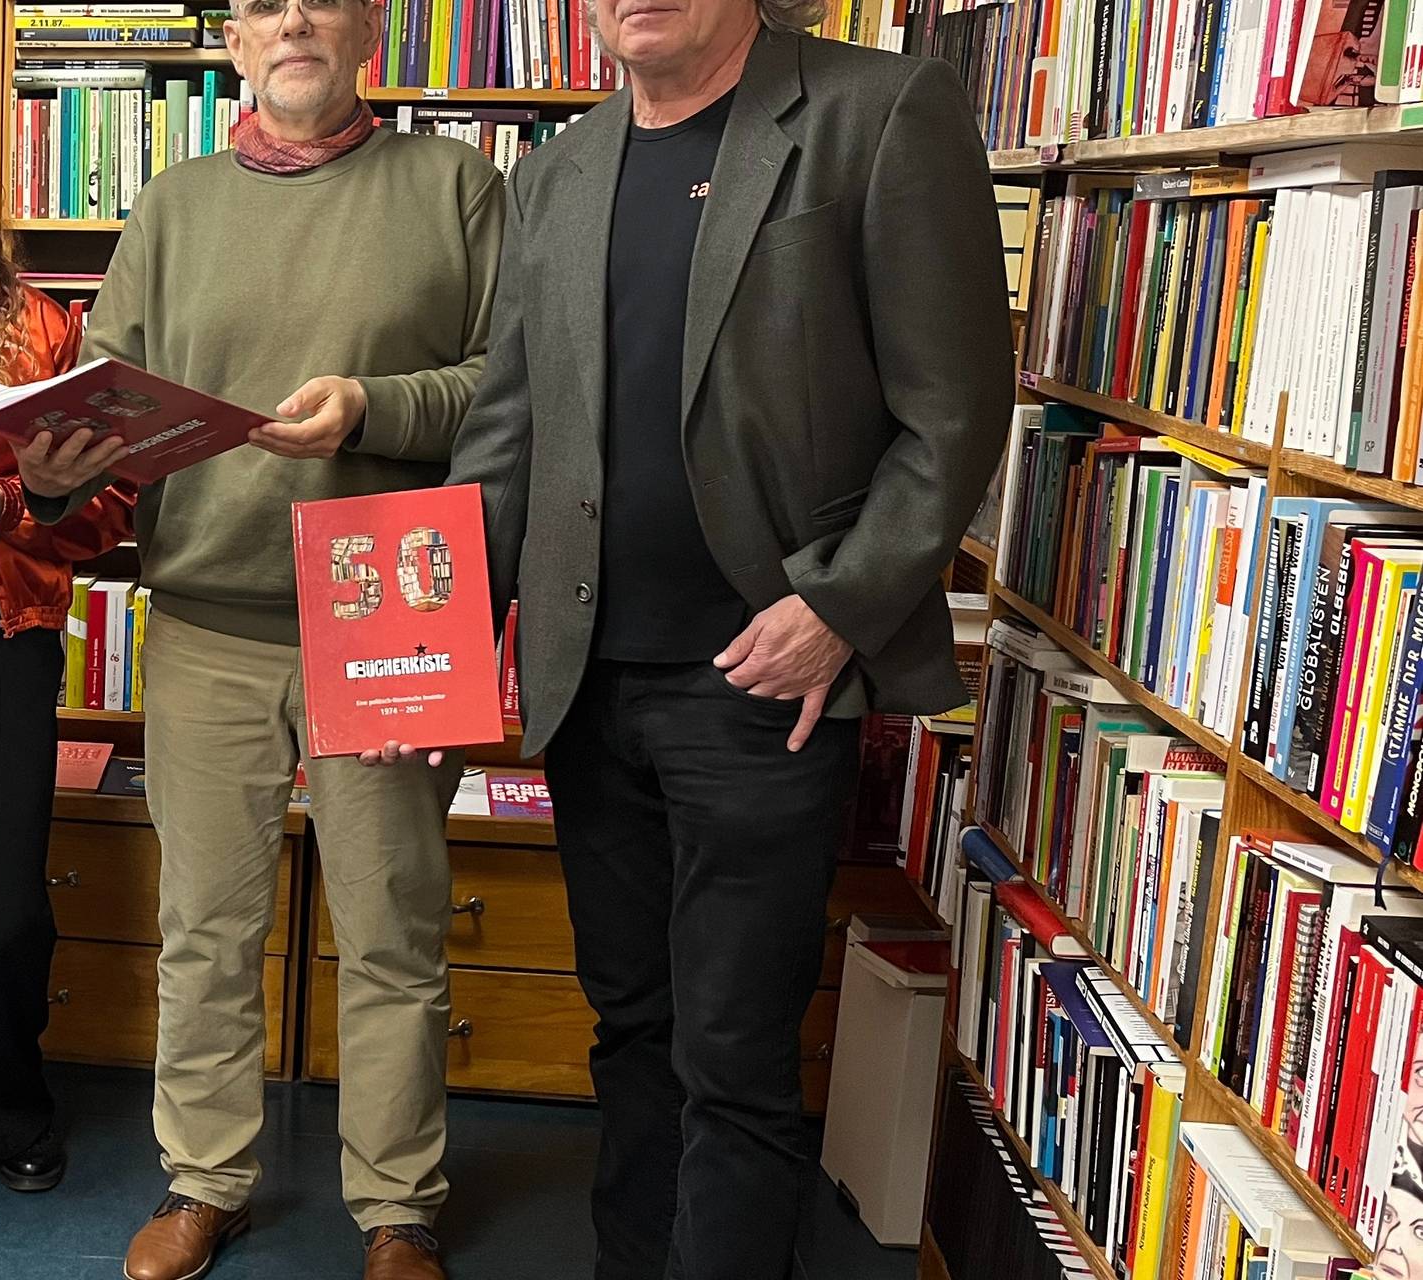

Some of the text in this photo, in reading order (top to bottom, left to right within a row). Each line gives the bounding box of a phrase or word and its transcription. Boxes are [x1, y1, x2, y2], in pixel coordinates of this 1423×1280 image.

[1096, 4, 1109, 92] KLASSENTHEORIE
[1354, 232, 1378, 395] MARX ANTHROPOCENE
[1399, 291, 1414, 348] PREDRAG
[330, 527, 454, 620] 50
[1218, 506, 1238, 585] GESELLSCHAFT
[1288, 522, 1305, 569] Werten
[1278, 600, 1296, 640] Waren
[1286, 574, 1298, 598] und
[354, 654, 451, 679] BÜCHERKISTE
[1252, 673, 1264, 709] BERTHOLD
[1258, 621, 1269, 640] VOM
[1276, 642, 1289, 670] Von
[1284, 618, 1301, 717] GLOBALISIERUNG
[1300, 567, 1330, 710] GLOBALISTEN
[380, 705, 424, 715] 1974 2024
[504, 667, 515, 710] Wir waren
[1269, 700, 1280, 732] Debra
[1388, 650, 1420, 759] STÄMME DER
[1314, 706, 1325, 741] HEIKE
[1308, 1048, 1318, 1079] NEGRI
[1321, 939, 1333, 991] WEALTH
[1138, 1156, 1156, 1250] Krisen im Kalten Krieg
